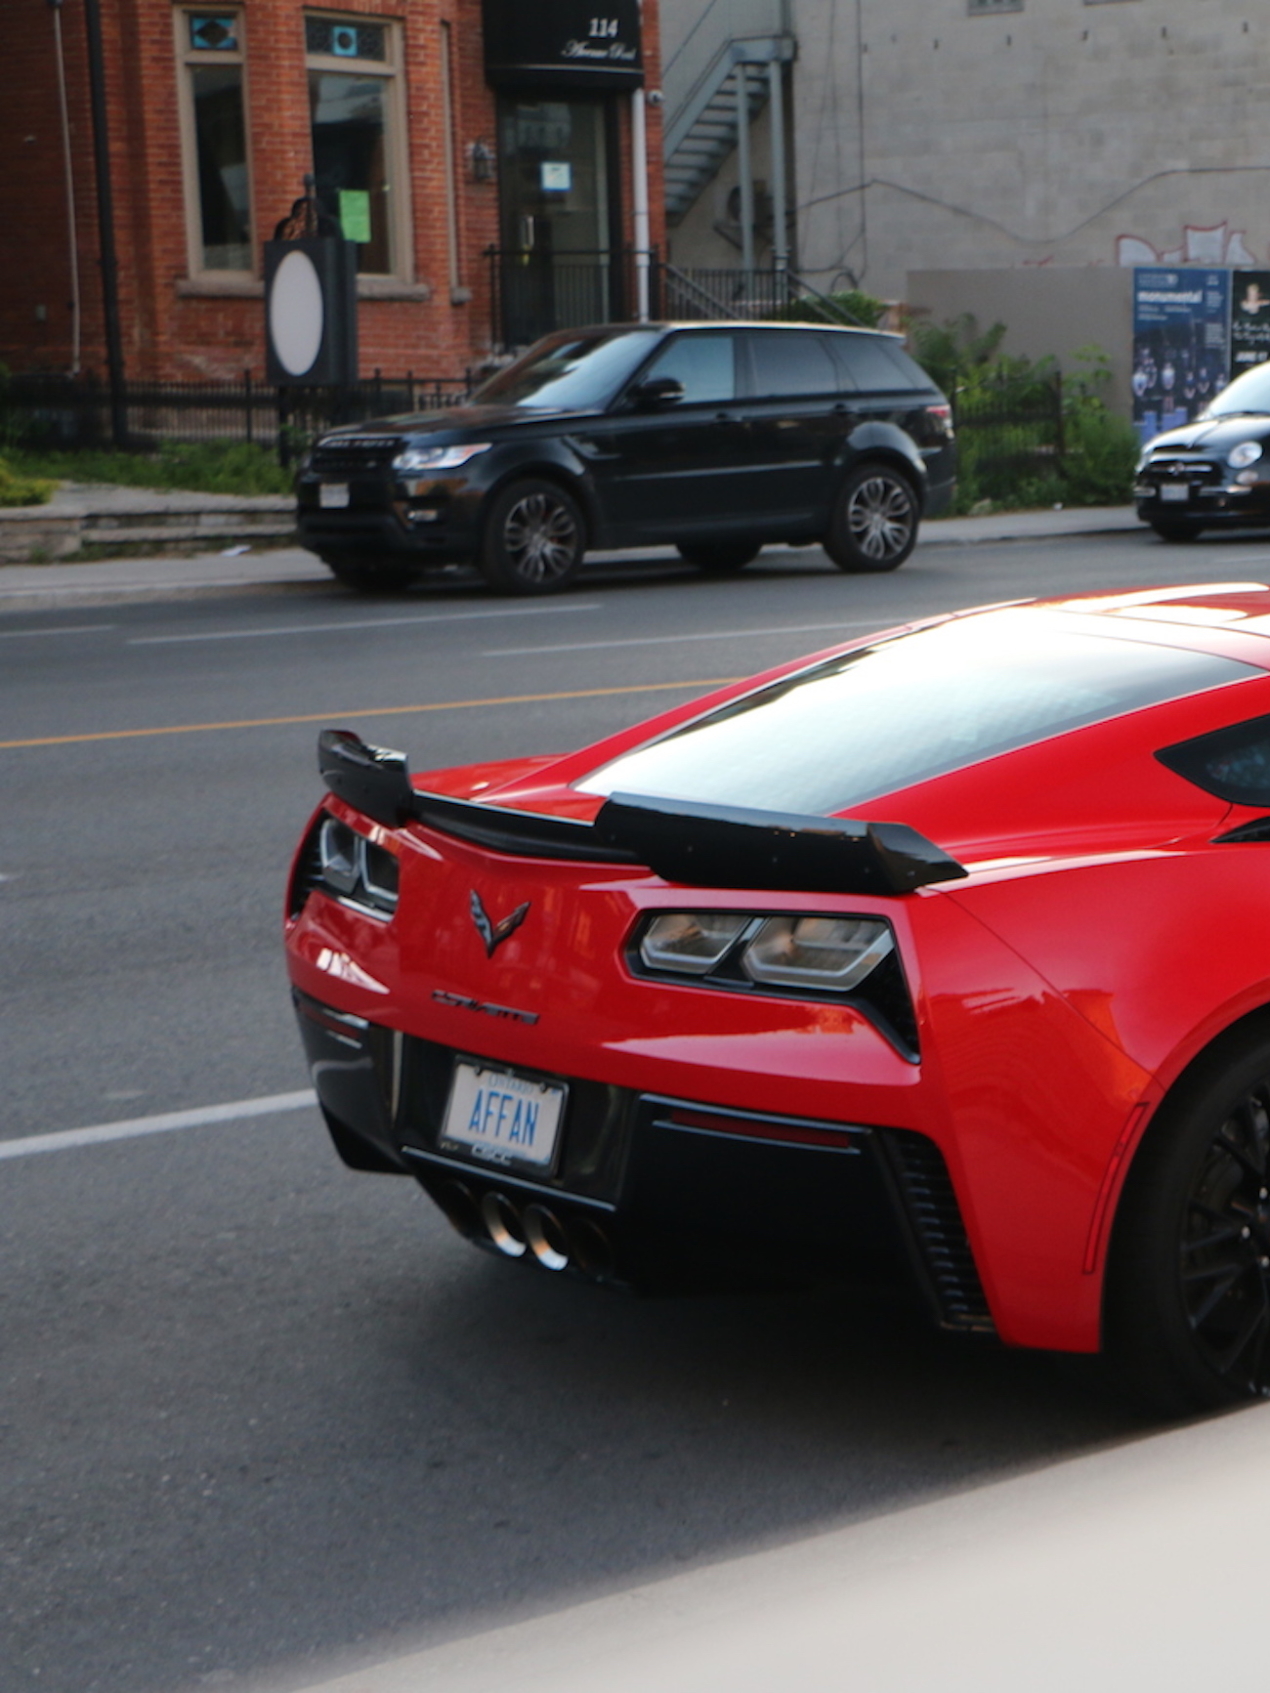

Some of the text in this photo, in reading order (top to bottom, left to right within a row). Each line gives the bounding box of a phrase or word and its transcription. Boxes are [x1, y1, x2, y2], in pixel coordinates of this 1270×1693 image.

[588, 18, 619, 38] 114
[1137, 290, 1203, 304] monumental
[468, 1089, 540, 1147] AFFAN
